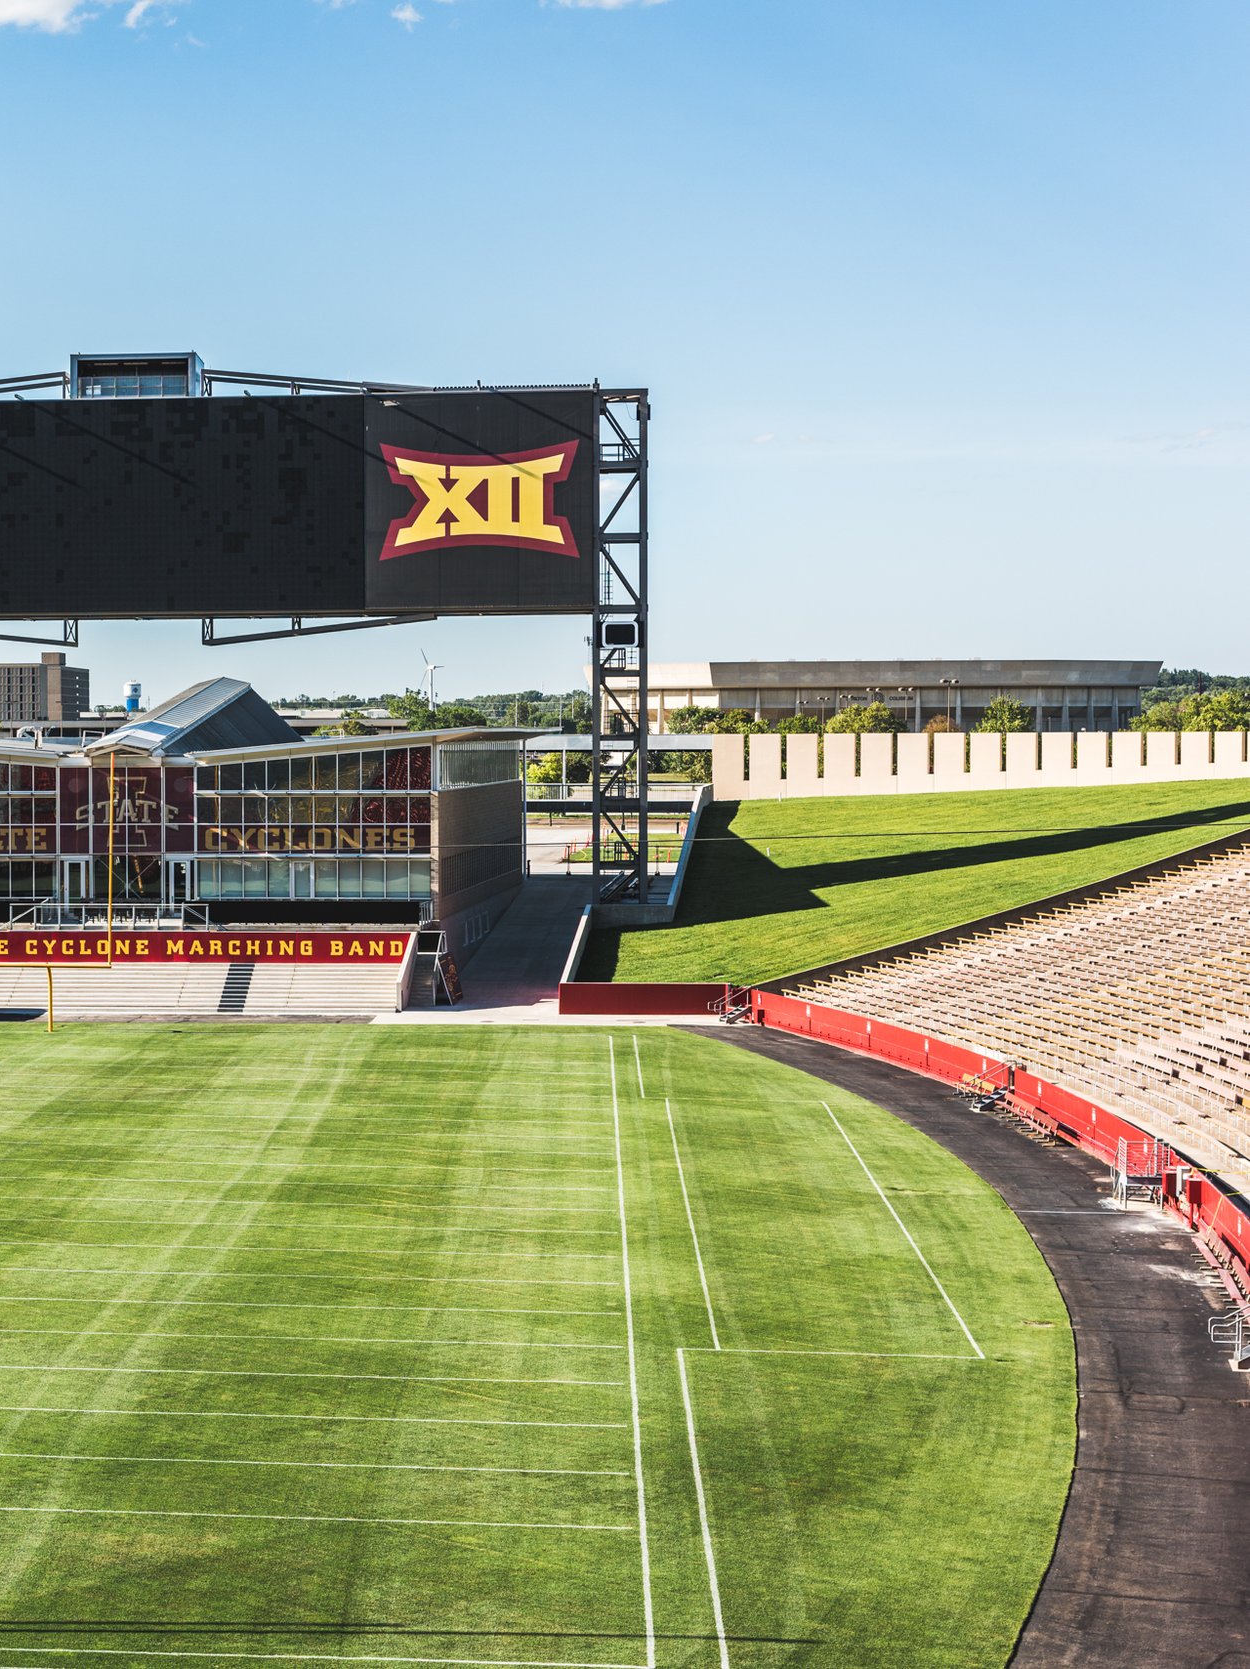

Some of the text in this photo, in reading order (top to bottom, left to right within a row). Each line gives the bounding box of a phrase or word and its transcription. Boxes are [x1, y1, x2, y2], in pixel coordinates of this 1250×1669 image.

[394, 453, 565, 547] XII
[75, 799, 179, 831] STATE
[204, 828, 416, 851] CYCLONES
[25, 939, 149, 955] CYCLONE
[166, 939, 313, 956] MARCHING
[330, 939, 404, 956] BAND
